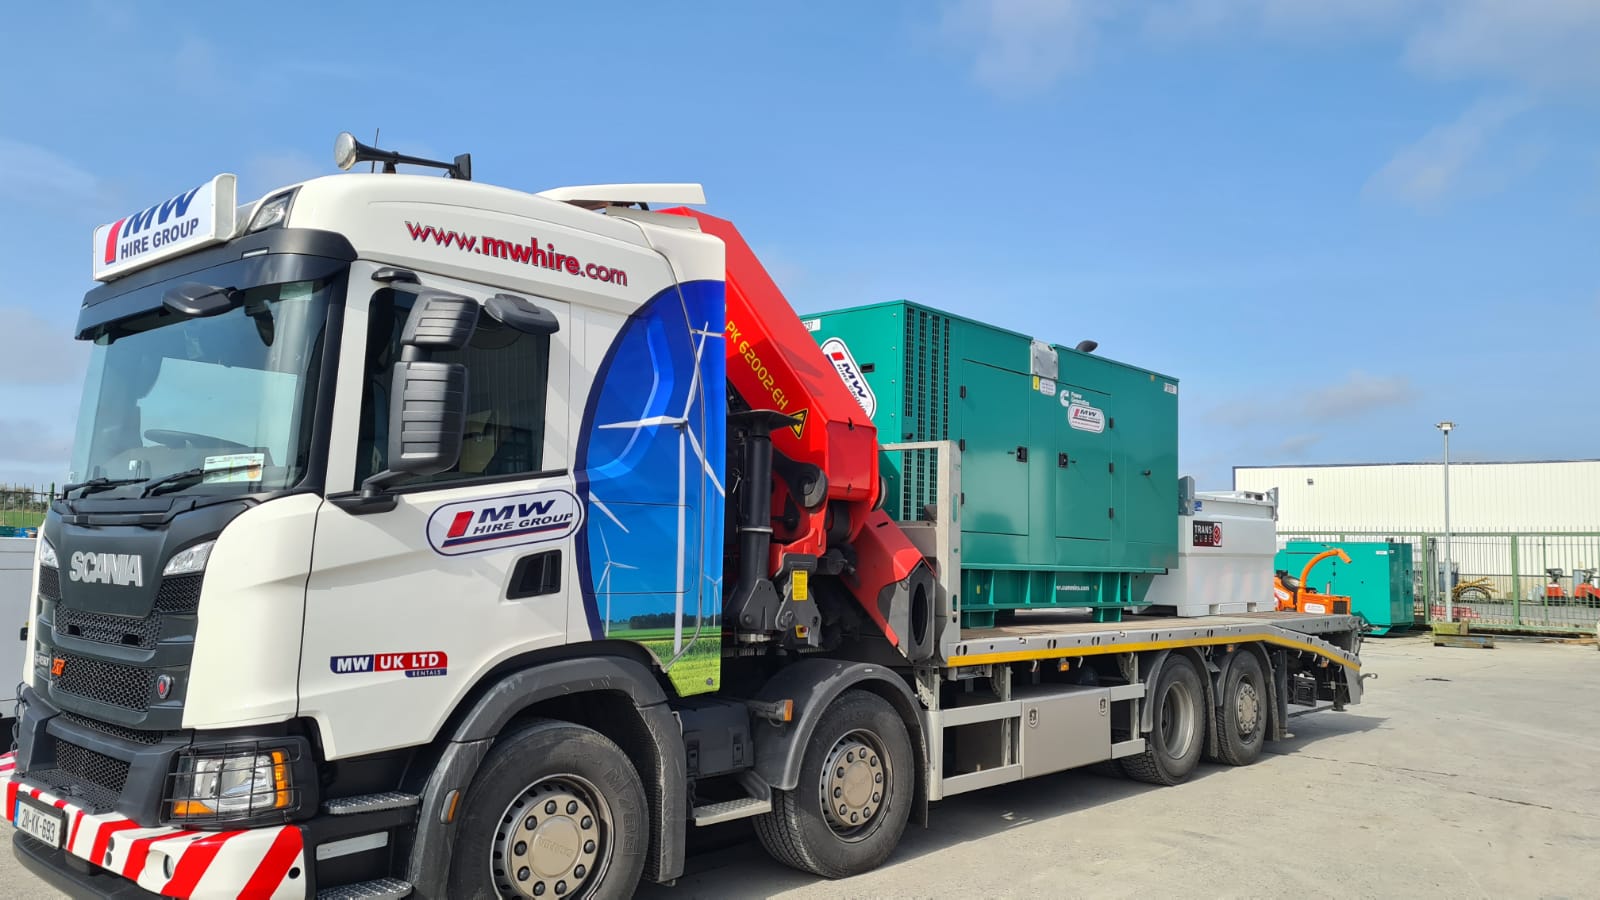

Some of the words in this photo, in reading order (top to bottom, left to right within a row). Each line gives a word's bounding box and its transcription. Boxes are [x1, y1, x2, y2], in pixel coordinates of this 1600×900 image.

[122, 186, 201, 238] MW
[121, 236, 149, 260] HIRE
[152, 217, 199, 248] GROUP
[404, 220, 628, 286] www.mwhire.com
[725, 320, 742, 343] PK
[842, 363, 867, 398] MW
[1079, 408, 1097, 417] MW
[478, 499, 556, 524] MW
[472, 521, 515, 535] HIRE
[518, 512, 573, 528] GROUP
[1194, 524, 1213, 535] TRANS
[1194, 534, 1213, 543] CUBE
[69, 550, 144, 587] SCANIA
[336, 656, 370, 673] MW
[380, 655, 405, 670] UK
[411, 653, 440, 668] LTD
[412, 669, 441, 677] RENTALS
